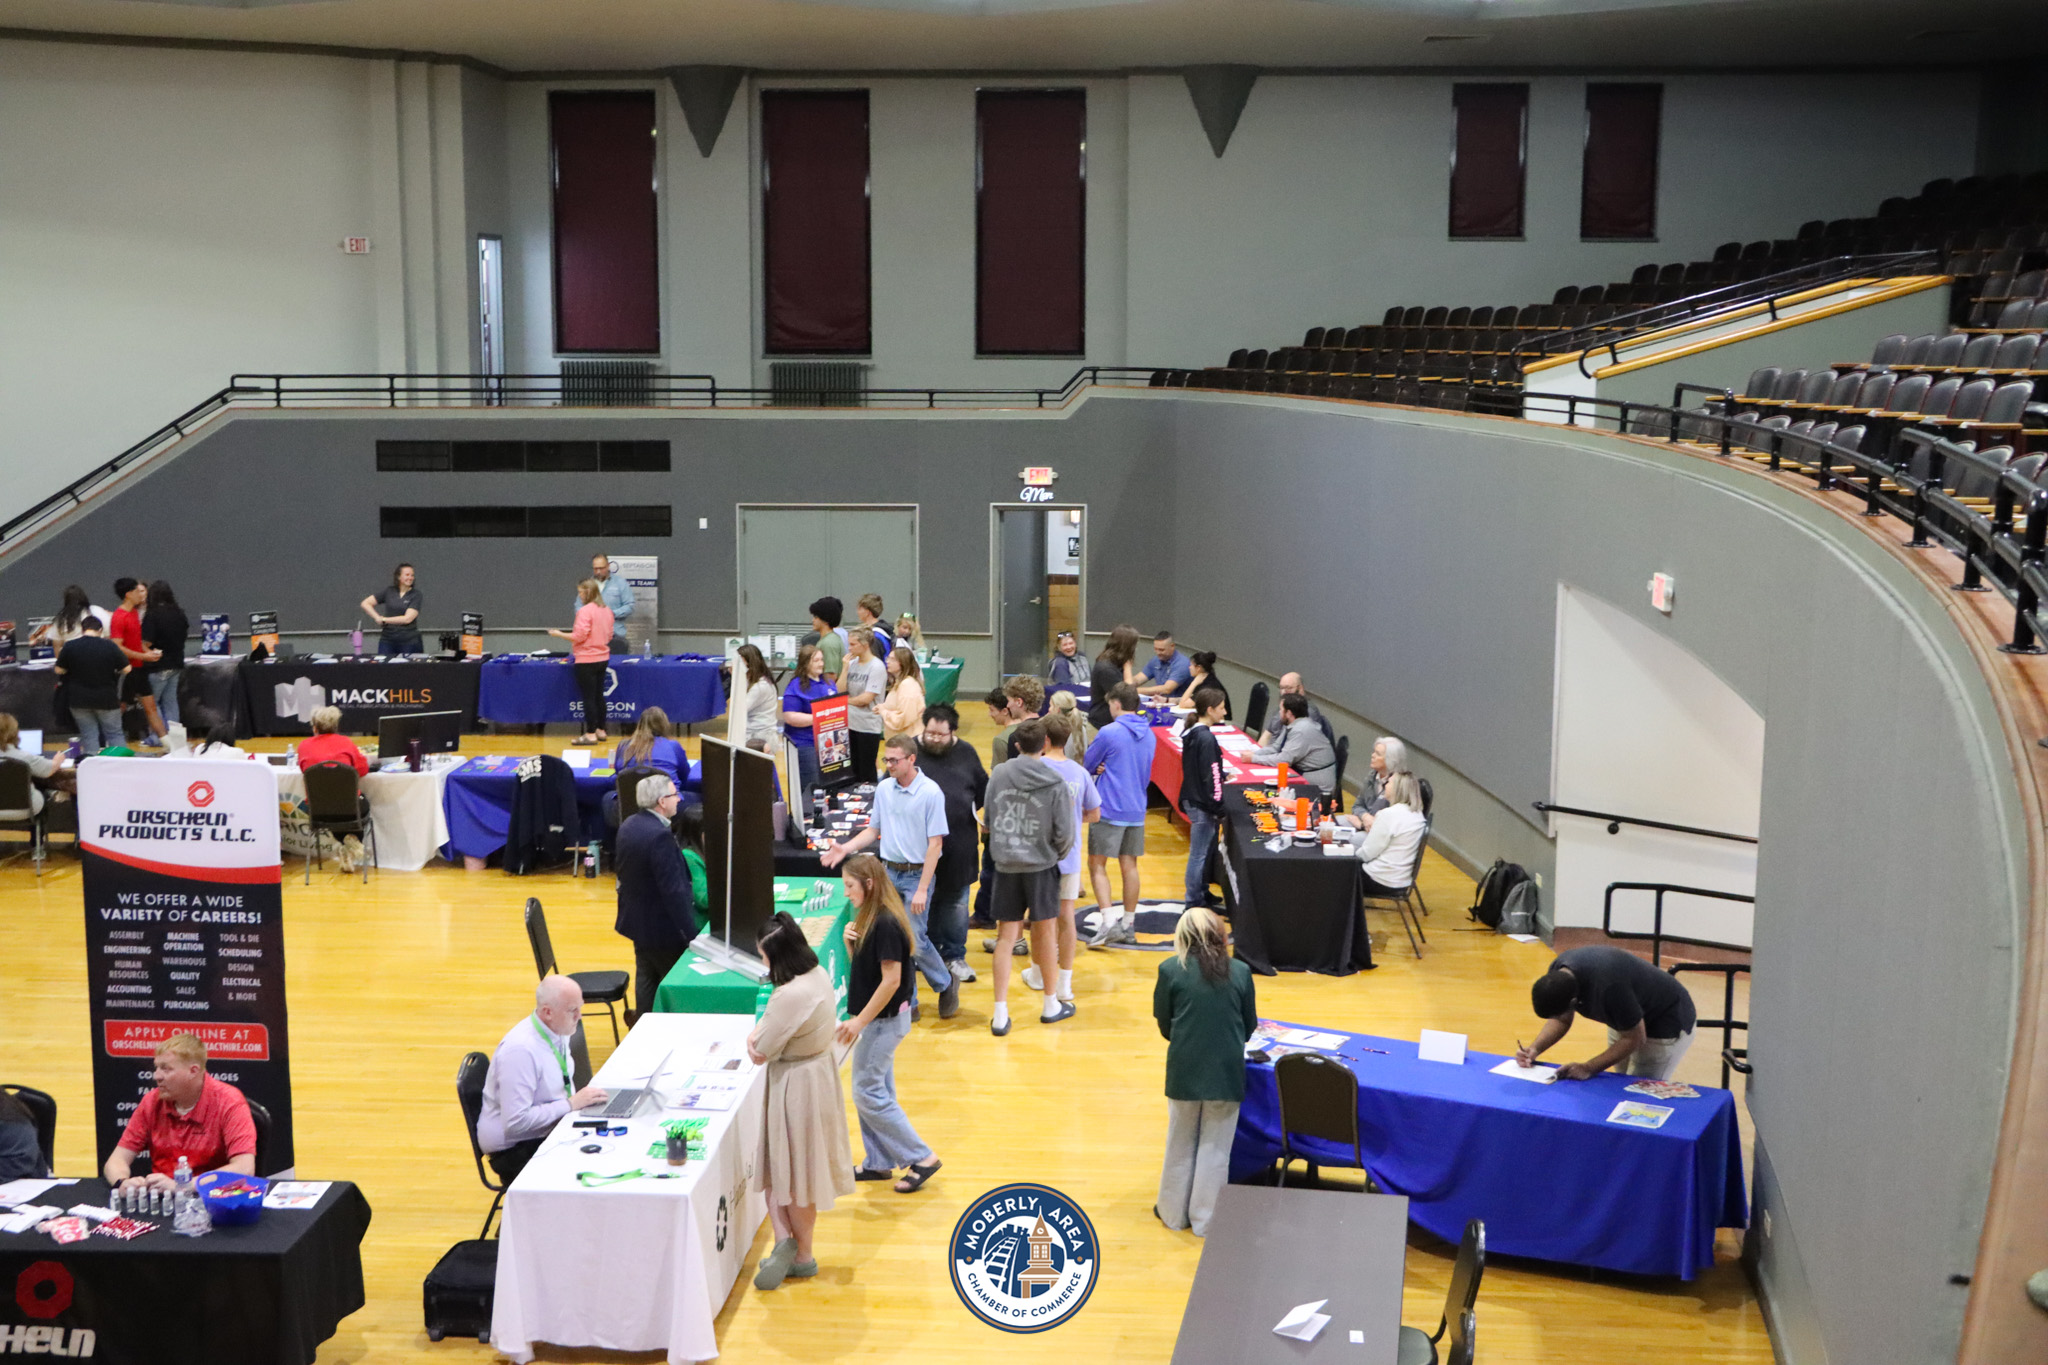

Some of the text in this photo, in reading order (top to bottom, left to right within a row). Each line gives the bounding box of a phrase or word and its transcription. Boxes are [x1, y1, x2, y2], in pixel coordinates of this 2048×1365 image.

[350, 238, 366, 252] EXIT
[1029, 468, 1049, 484] EXIT
[331, 688, 433, 704] MACKHILS
[569, 701, 636, 712] SEGON
[127, 810, 229, 827] ORSCHELN
[98, 824, 256, 843] PRODUCTS L.L.C.
[117, 892, 244, 908] WE OFFER A WIDE
[100, 908, 262, 924] VARIETY OF CAREERS!
[109, 931, 145, 940] ASSEMBLY
[167, 932, 199, 941] MACHINE
[219, 933, 238, 943] TOOL
[247, 934, 260, 943] DIE
[103, 945, 152, 955] ENGINEERING
[163, 942, 204, 951] OPERATION
[218, 948, 263, 958] SCHEDULING
[114, 960, 142, 969] HUMAN
[162, 957, 207, 966] WAREHOUSE
[227, 963, 254, 972] DESIGN
[109, 970, 149, 979] RESOURCES
[170, 972, 201, 981] QUALITY
[222, 978, 262, 987] ELECTRICAL
[107, 985, 152, 994] ACCOUNTING
[176, 986, 196, 995] SALES
[236, 992, 257, 1001] MORE
[105, 999, 155, 1008] MAINTENANCE
[163, 1001, 209, 1010] PURCHASING
[124, 1026, 250, 1041] APPLY ONLINE AT
